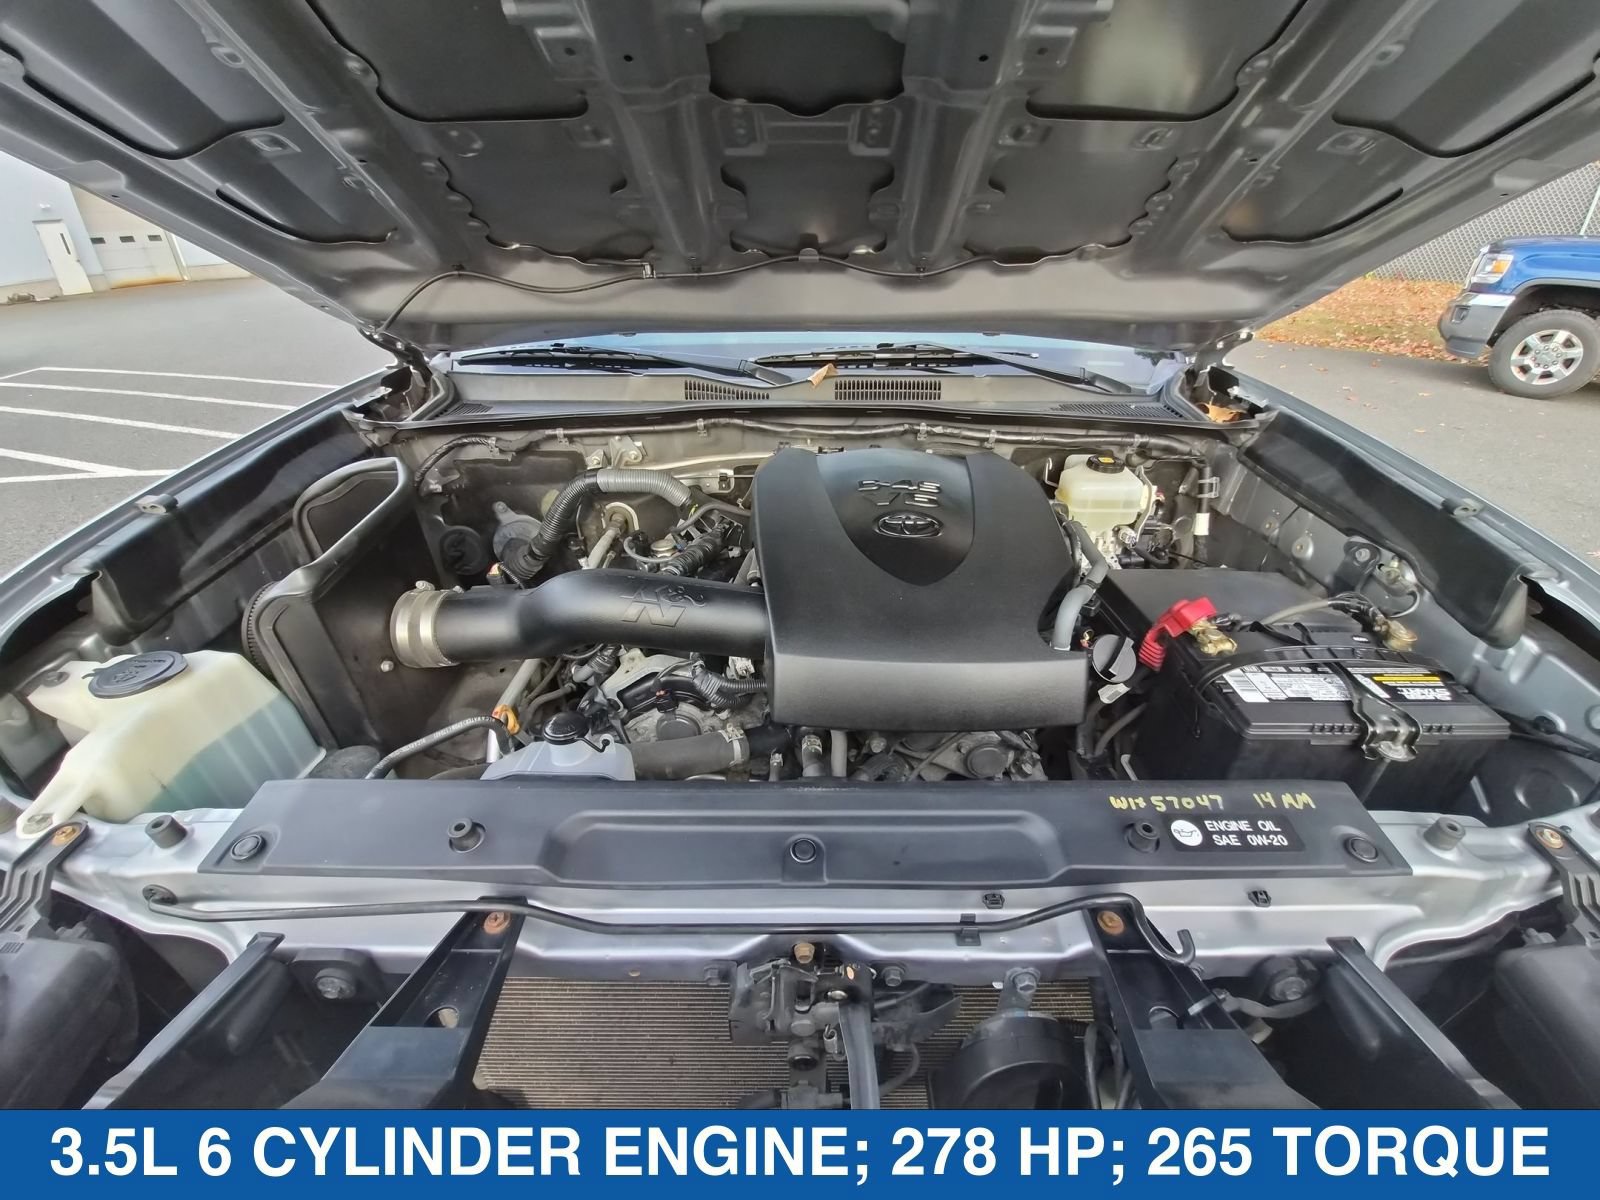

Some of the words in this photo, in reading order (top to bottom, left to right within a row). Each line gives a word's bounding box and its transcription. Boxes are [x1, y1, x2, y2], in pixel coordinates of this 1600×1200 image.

[1150, 795, 1224, 812] 57047
[1253, 792, 1277, 809] 14
[1204, 820, 1254, 832] ENGINE
[1257, 820, 1282, 832] OIL
[1212, 834, 1242, 846] SAE
[1246, 834, 1289, 846] 0W-20
